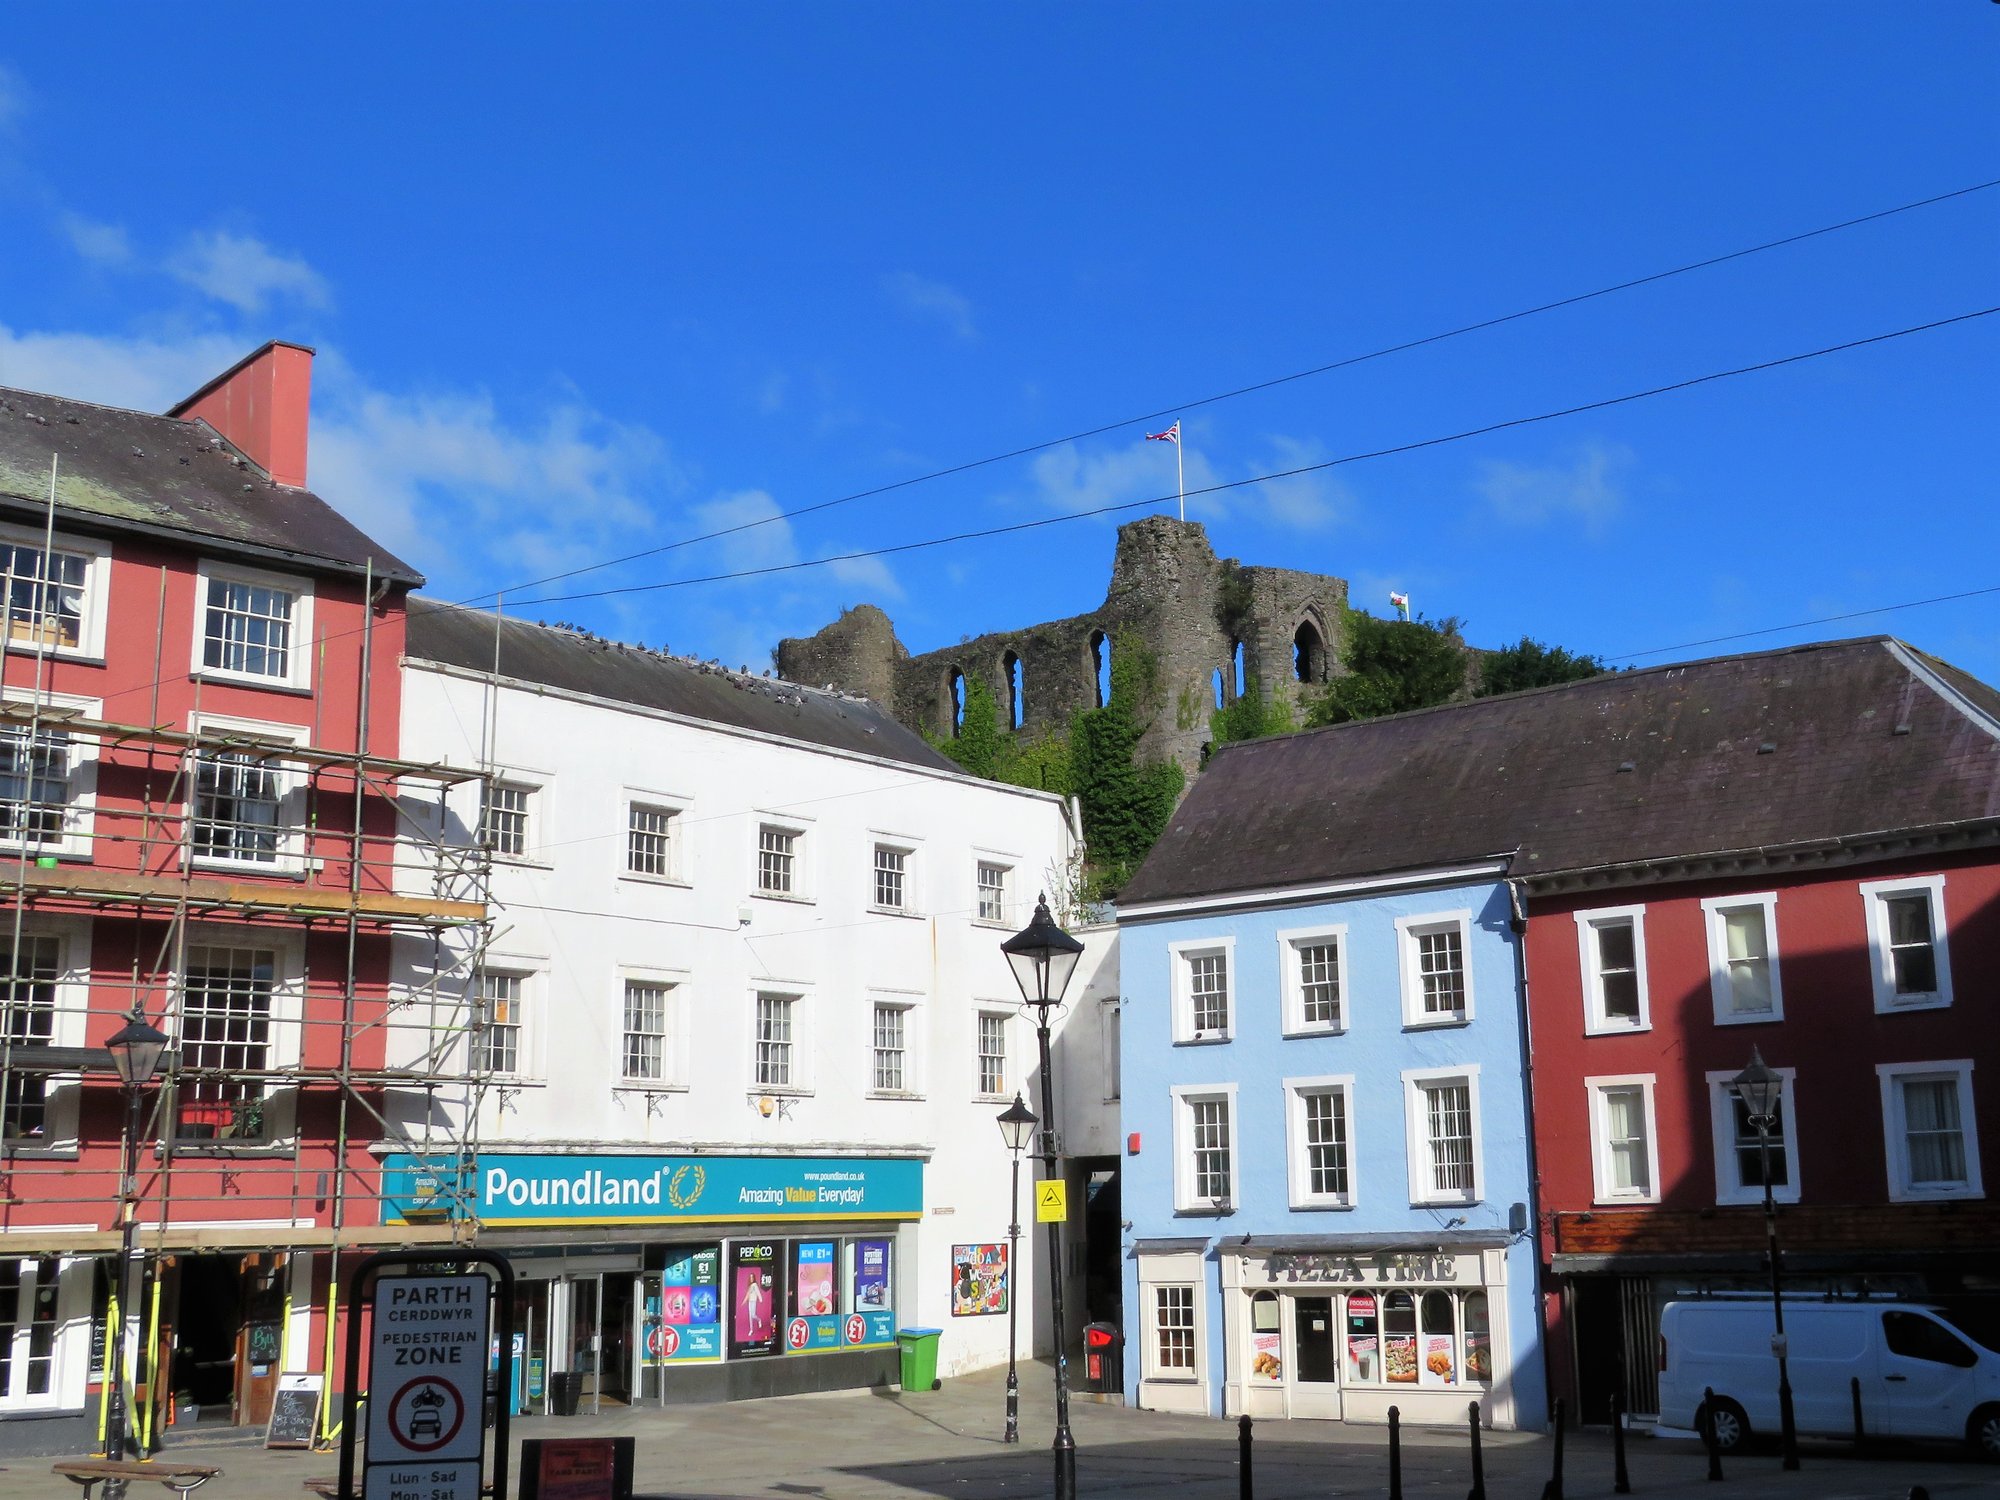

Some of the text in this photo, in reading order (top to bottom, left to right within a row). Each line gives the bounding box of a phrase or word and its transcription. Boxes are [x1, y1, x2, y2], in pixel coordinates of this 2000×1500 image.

[804, 1171, 865, 1182] www.poundland.co.uk
[485, 1167, 661, 1206] Poundland
[739, 1186, 864, 1206] Amazing Value Everyday!
[1266, 1253, 1458, 1282] PIZZA TIME
[392, 1286, 471, 1305] PARTH
[388, 1308, 473, 1321] CERDDWYR
[382, 1331, 477, 1344] PEDESTRIAN
[791, 1324, 806, 1344] £1
[848, 1319, 862, 1340] £1
[394, 1346, 462, 1365] ZONE
[390, 1472, 419, 1485] Llun
[431, 1470, 457, 1483] Sad
[390, 1491, 420, 1500] Mon
[431, 1488, 455, 1500] Sat
